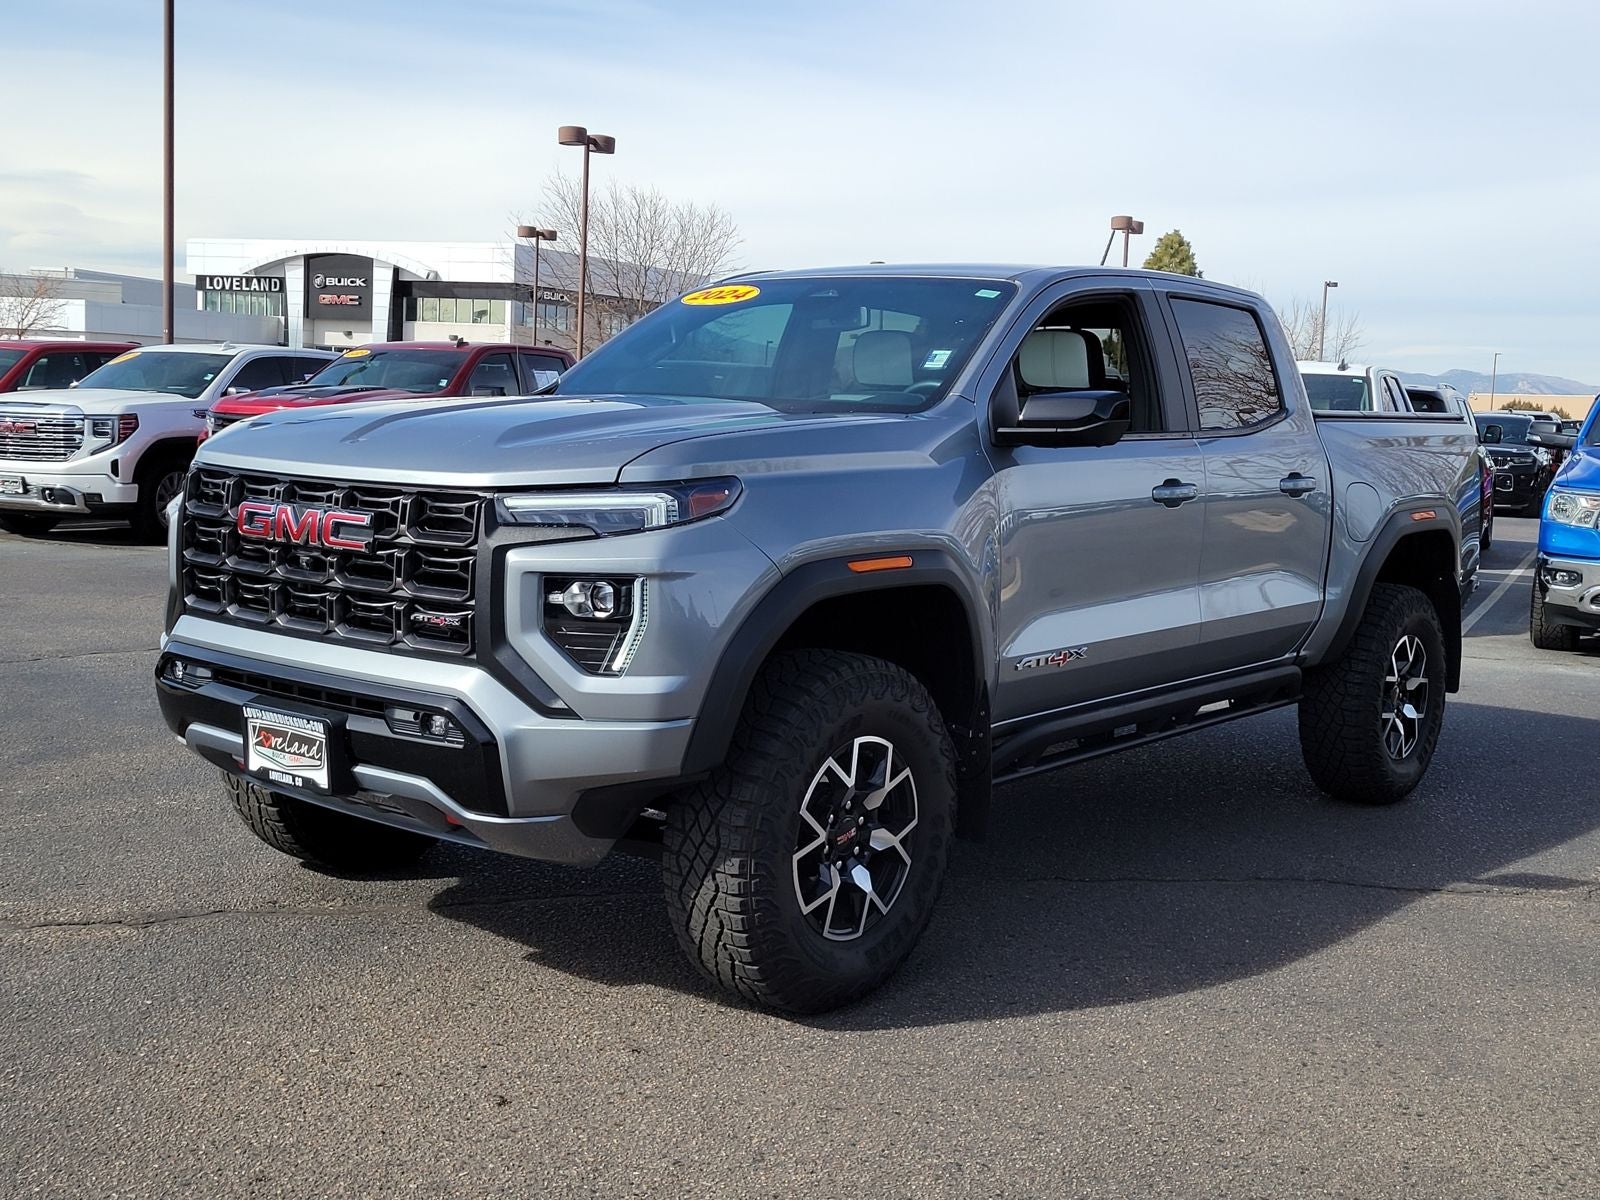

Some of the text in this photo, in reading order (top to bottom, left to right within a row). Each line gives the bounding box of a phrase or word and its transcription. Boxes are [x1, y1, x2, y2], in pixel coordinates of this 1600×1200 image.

[206, 277, 280, 292] LOVELAND
[325, 277, 366, 287] BUICK
[318, 294, 360, 305] GMC
[237, 501, 374, 551] GMC
[1014, 646, 1088, 672] AT4X
[295, 776, 303, 787] CO
